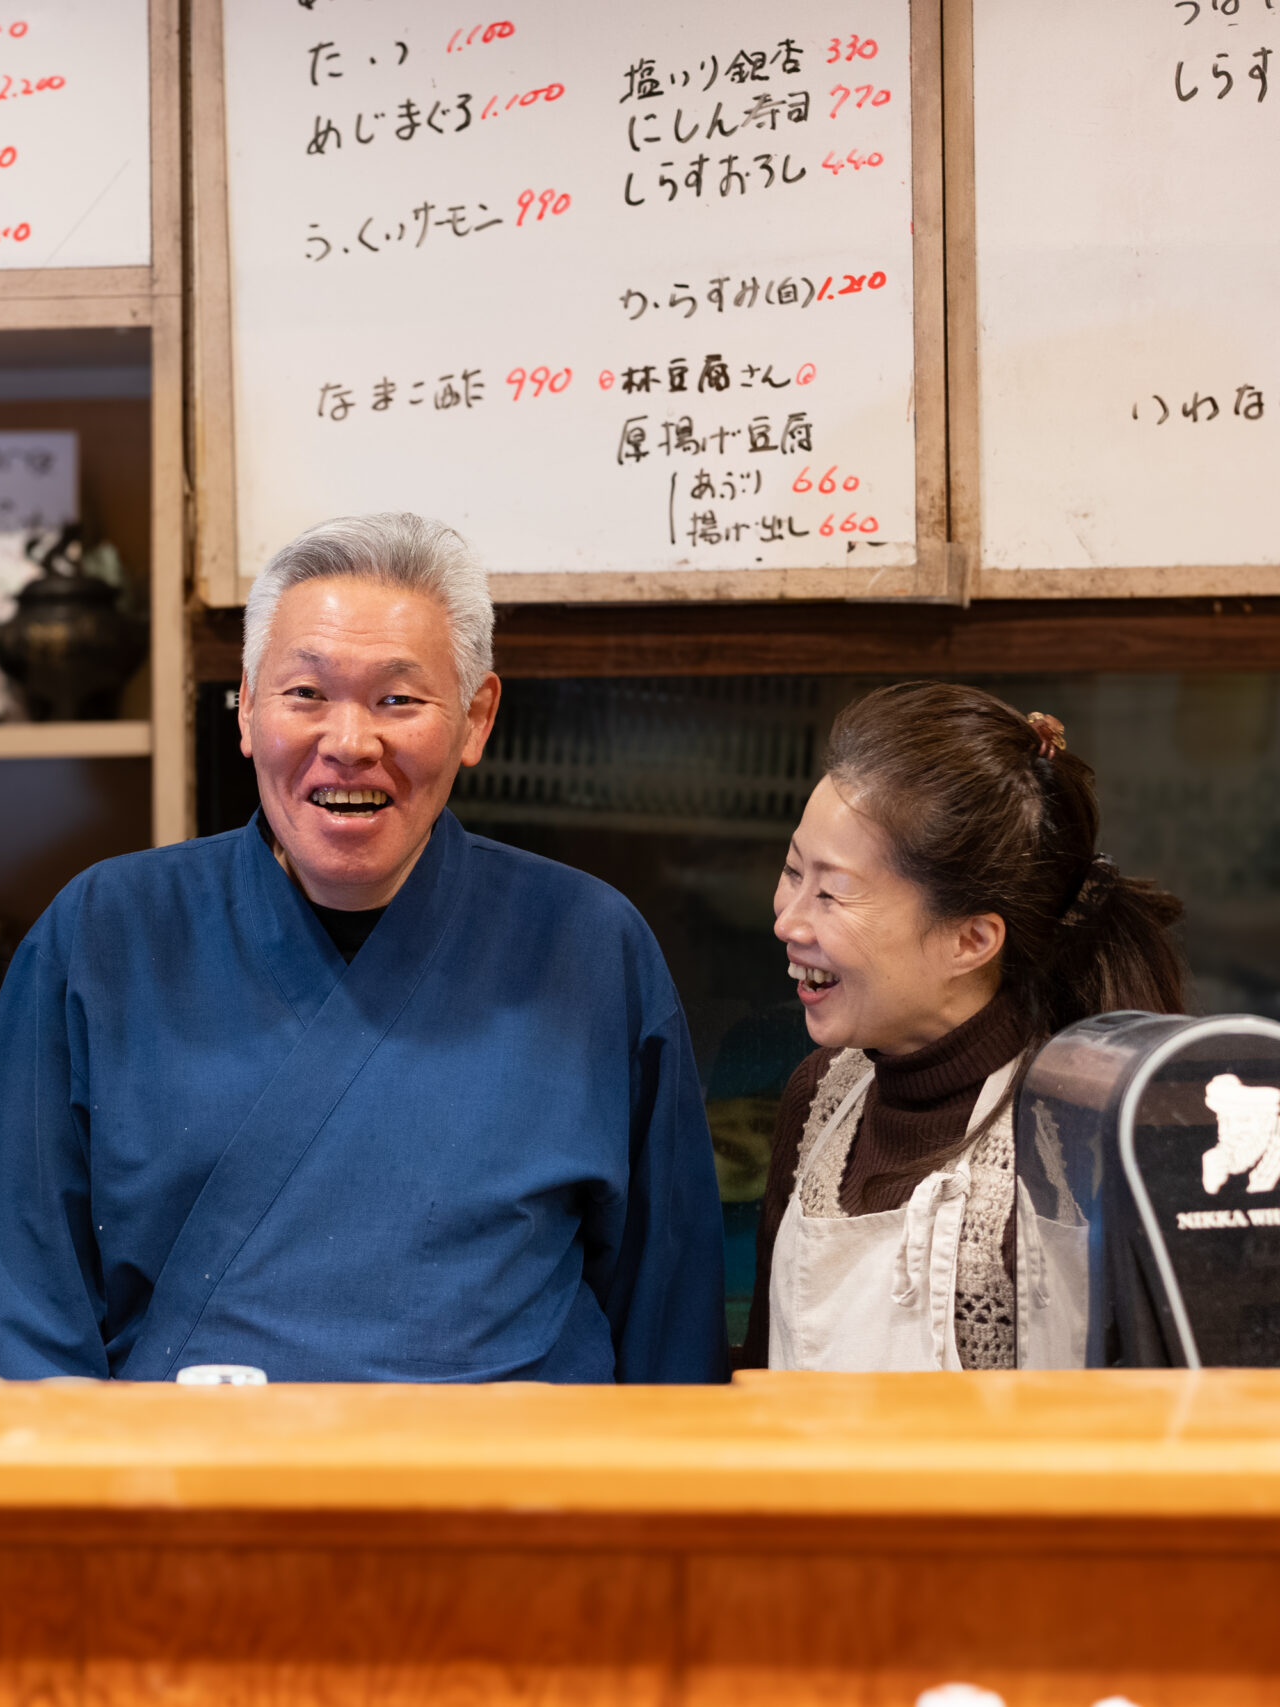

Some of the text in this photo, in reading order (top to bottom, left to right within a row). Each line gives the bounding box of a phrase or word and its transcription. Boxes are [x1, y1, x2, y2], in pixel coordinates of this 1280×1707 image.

[825, 33, 879, 65] 330
[306, 92, 473, 156] めじまぐろ
[623, 83, 892, 153] にしん寿司 770
[624, 148, 885, 207] しらすおろし 440
[515, 188, 572, 228] 990
[317, 365, 573, 422] なまこ酢 990
[1131, 383, 1265, 426] いわな
[616, 411, 814, 467] 厚揚げ豆腐
[689, 464, 861, 501] あぶり 660
[685, 509, 880, 548] 揚げ出し 660
